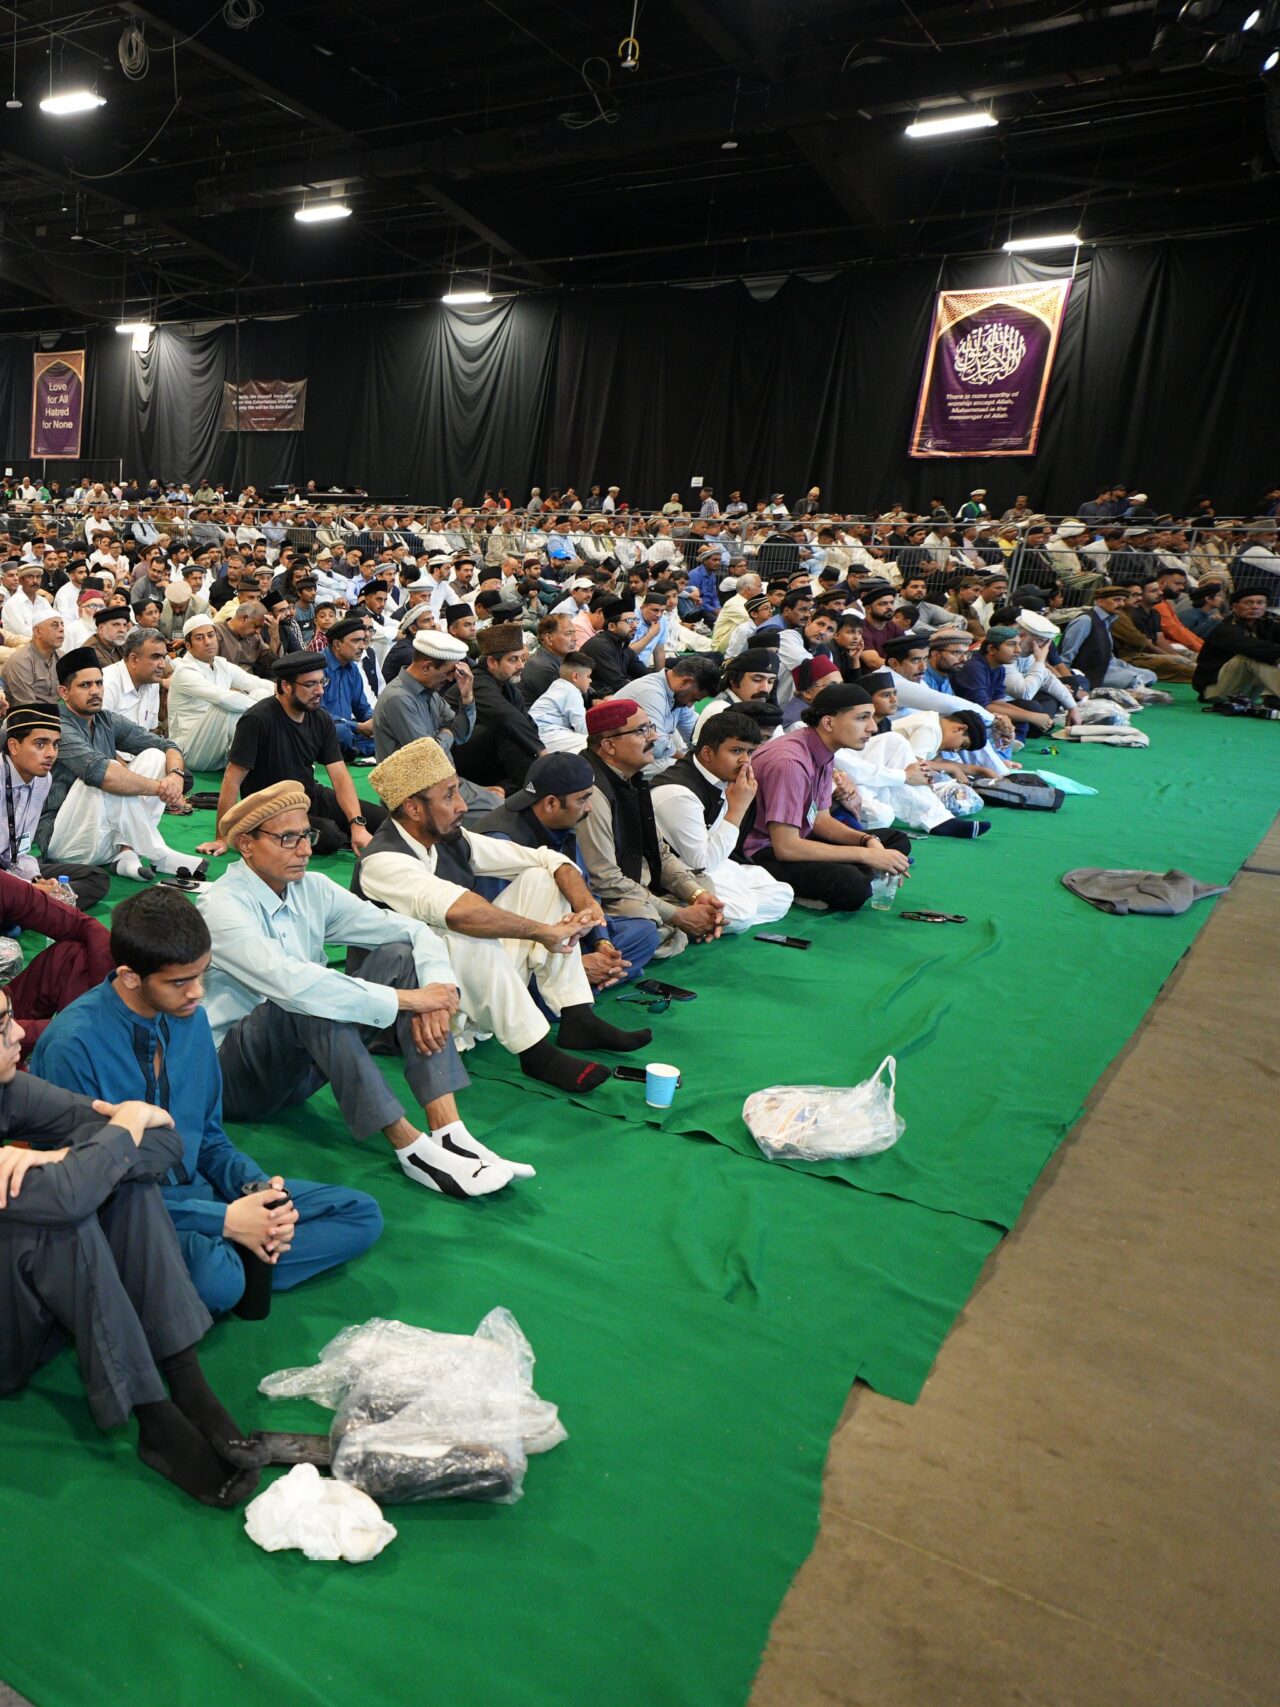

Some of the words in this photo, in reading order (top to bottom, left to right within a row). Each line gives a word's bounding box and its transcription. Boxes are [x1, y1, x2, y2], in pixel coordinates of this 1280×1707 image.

[49, 383, 67, 391] Love
[47, 395, 58, 404] for
[58, 395, 69, 403] All
[45, 407, 69, 416] Hatred
[42, 421, 52, 429] for
[53, 420, 73, 429] None
